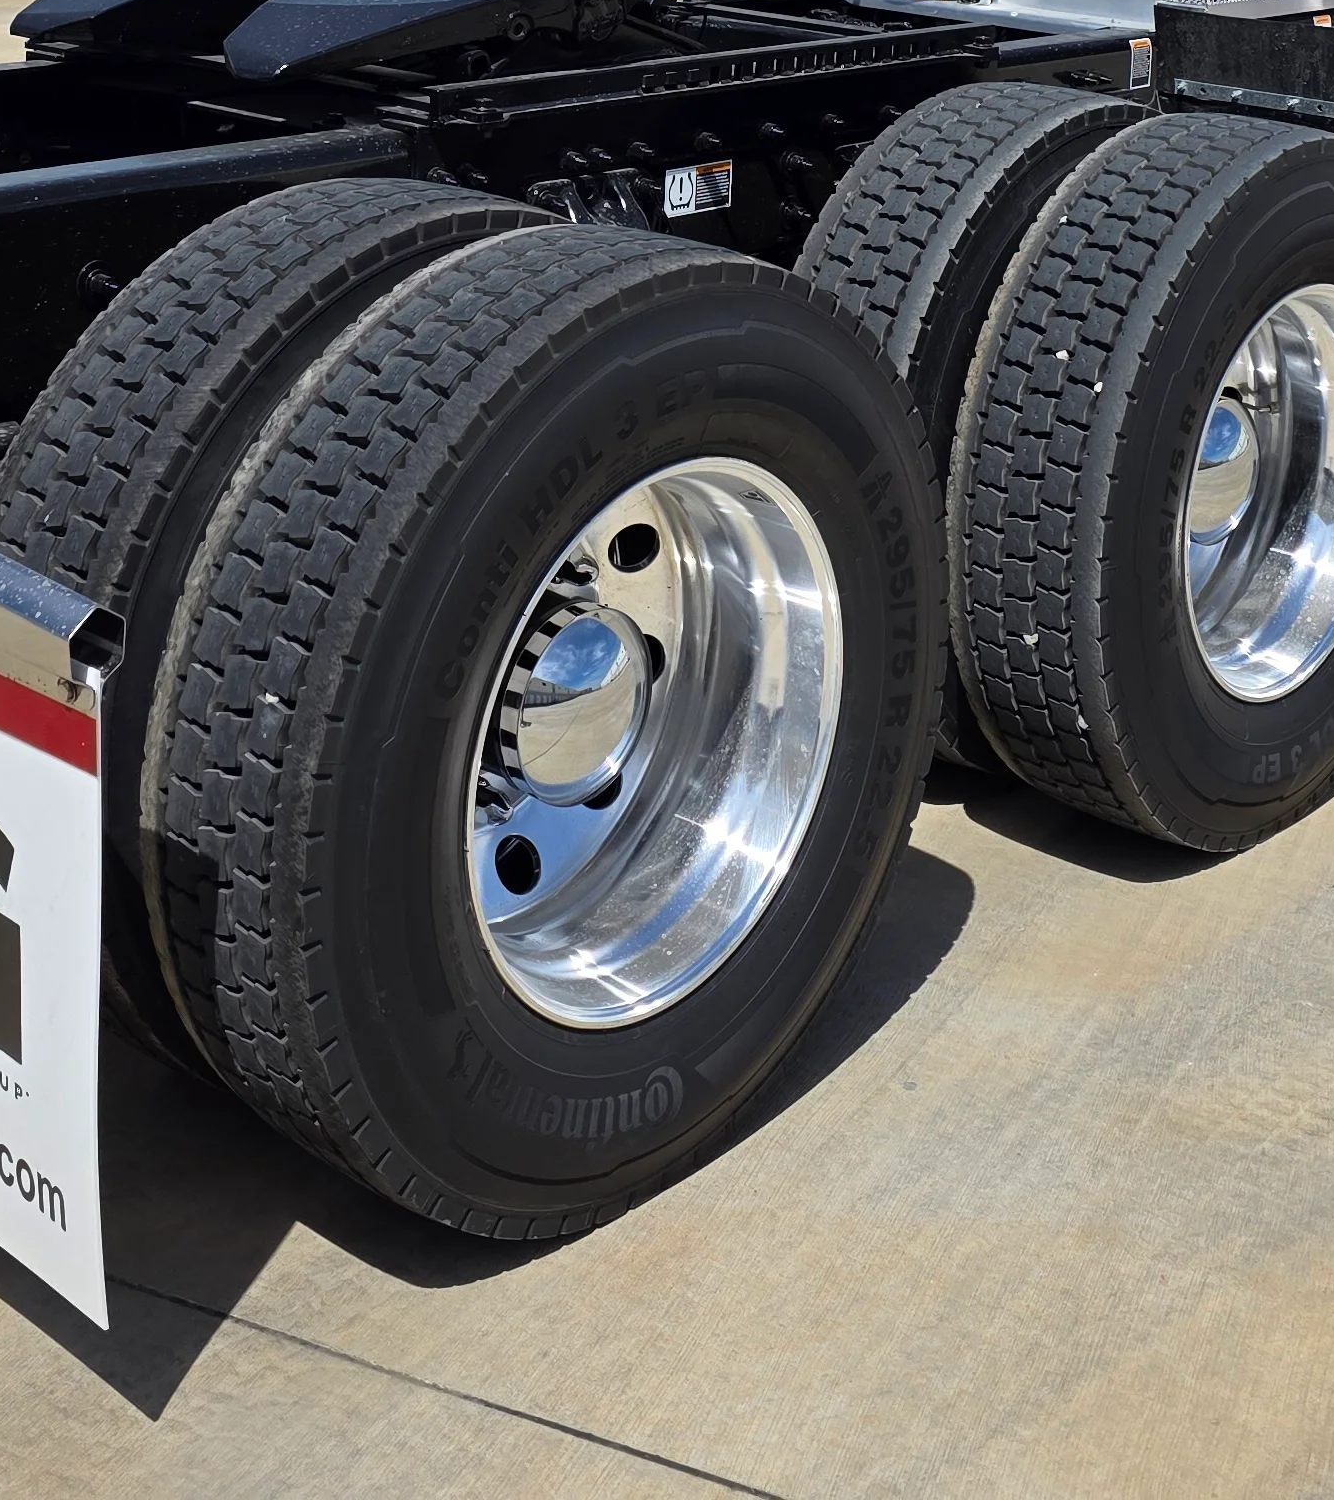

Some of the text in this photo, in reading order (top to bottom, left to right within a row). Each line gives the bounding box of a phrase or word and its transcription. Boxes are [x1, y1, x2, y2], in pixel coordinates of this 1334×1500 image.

[434, 538, 520, 701] Conti
[518, 436, 604, 537] HDL
[654, 368, 707, 419] EP
[463, 1052, 684, 1152] Continental
